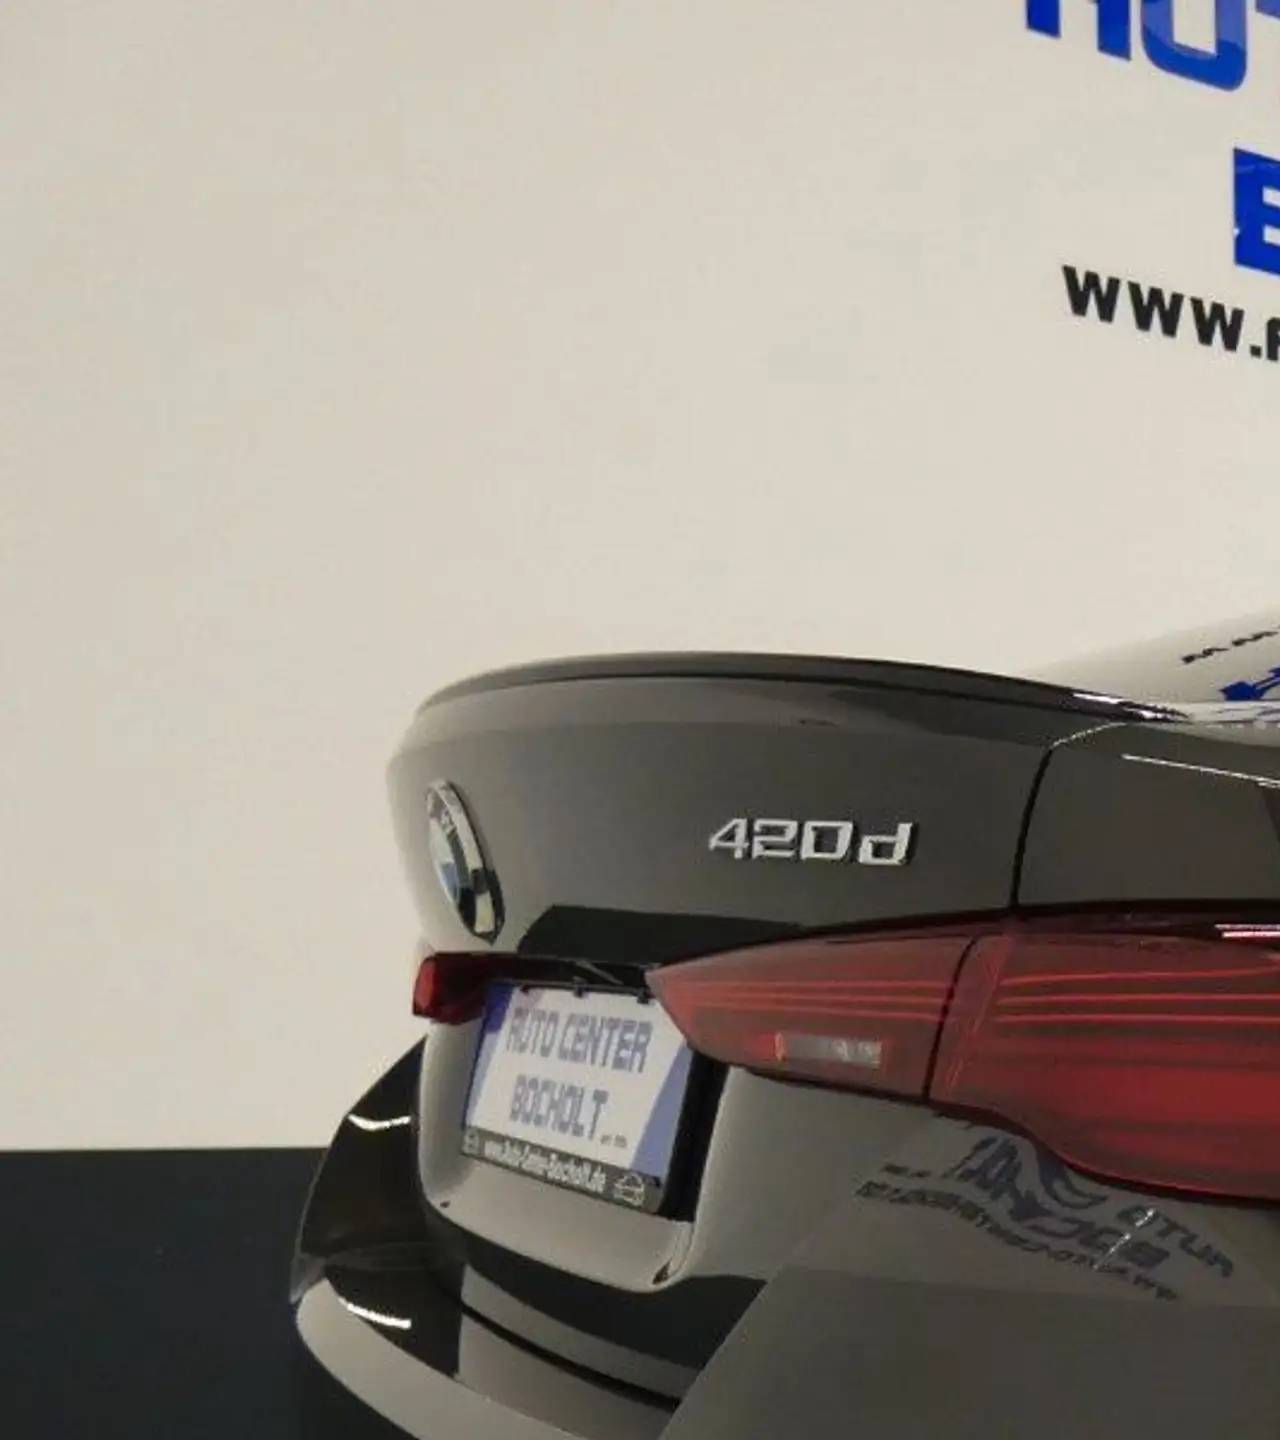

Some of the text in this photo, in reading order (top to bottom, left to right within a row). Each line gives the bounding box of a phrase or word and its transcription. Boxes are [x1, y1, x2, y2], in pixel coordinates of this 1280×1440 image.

[708, 817, 914, 866] 420d
[557, 1012, 653, 1075] CENTER
[509, 1073, 610, 1142] BOCHOLT
